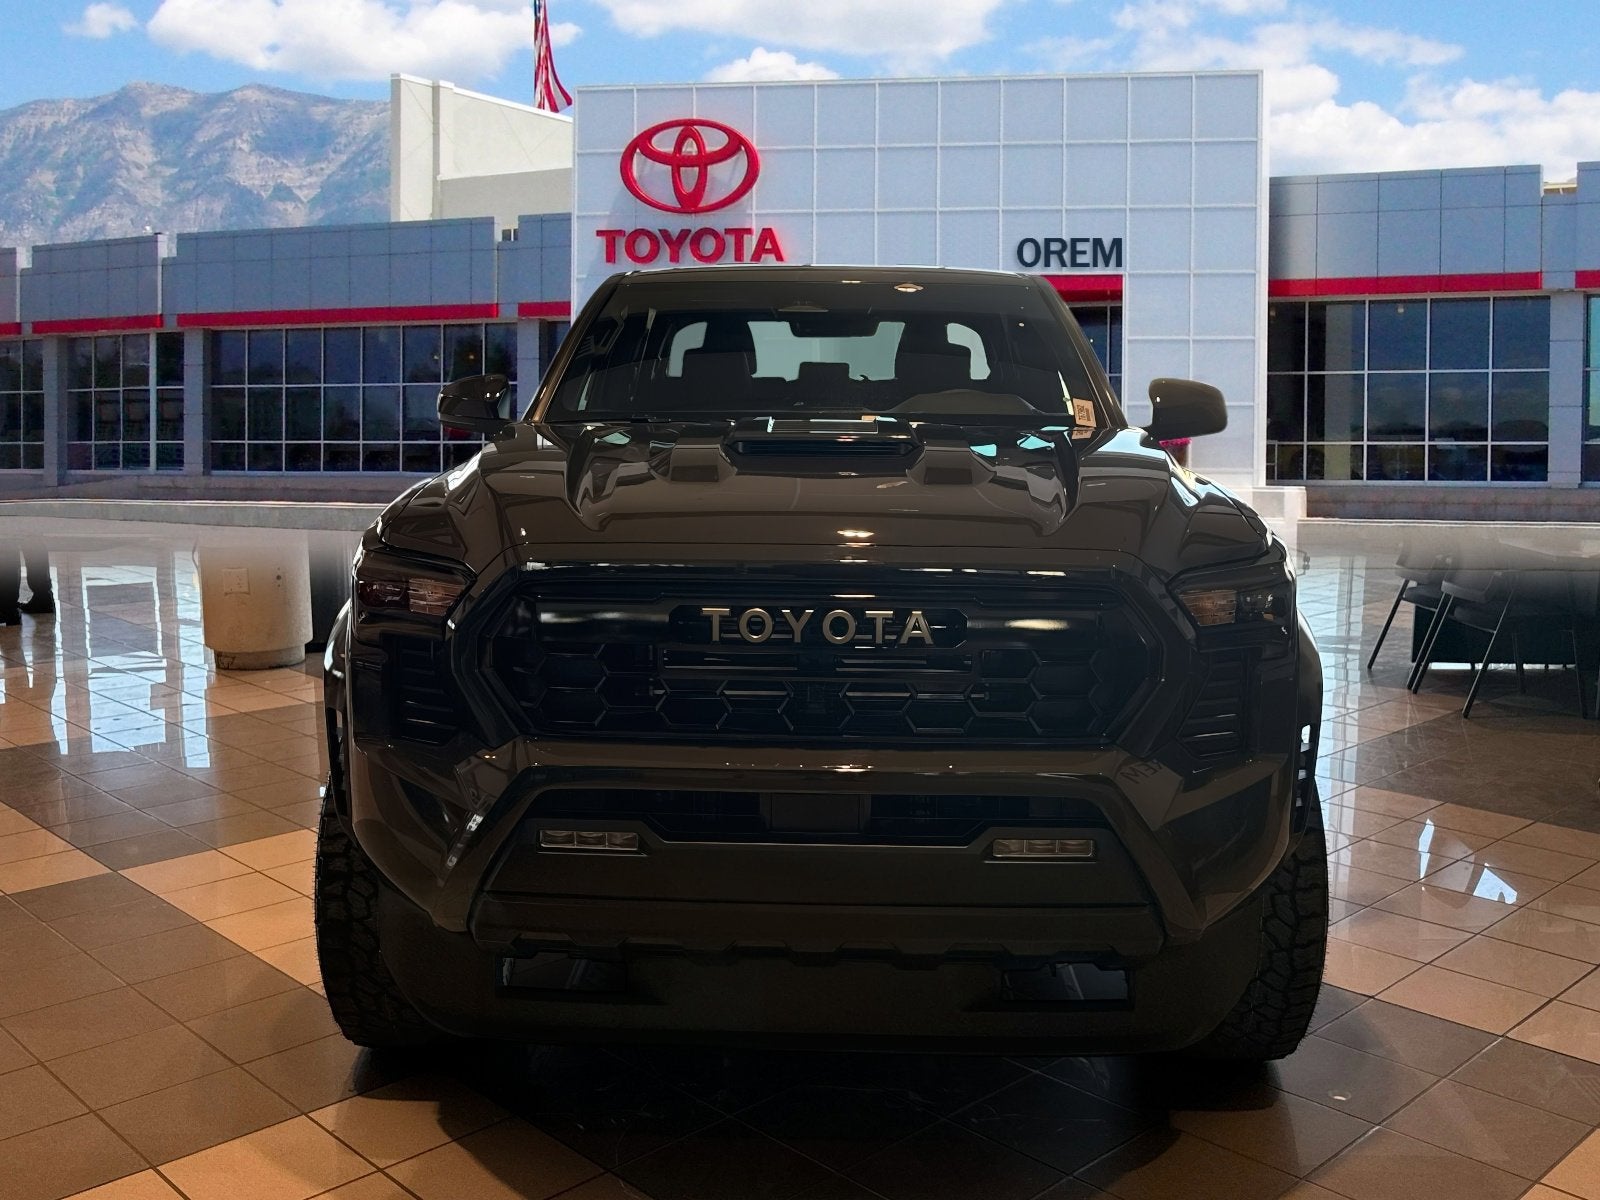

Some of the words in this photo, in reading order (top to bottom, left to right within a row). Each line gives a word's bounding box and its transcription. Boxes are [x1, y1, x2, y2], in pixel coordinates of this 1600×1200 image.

[596, 227, 785, 264] TOYOTA
[1017, 237, 1123, 268] OREM
[702, 607, 934, 645] TOYOTA
